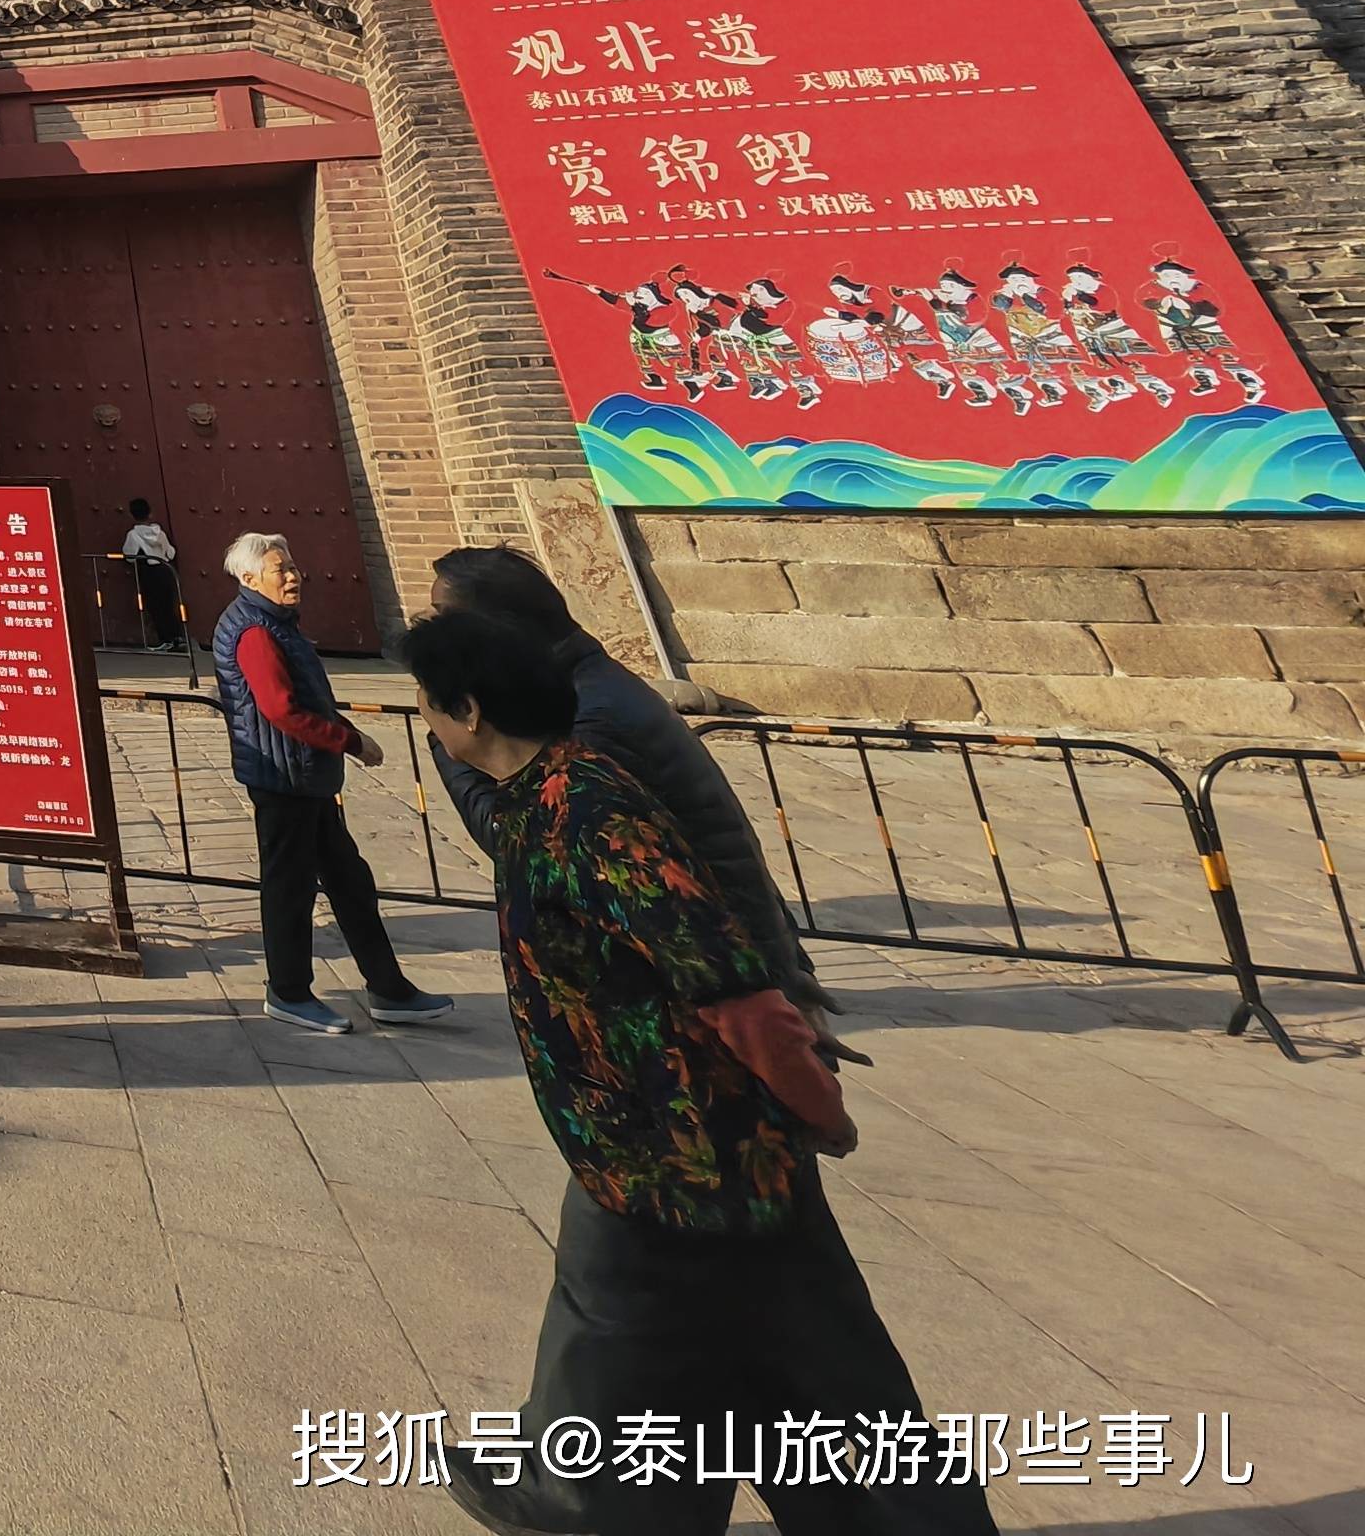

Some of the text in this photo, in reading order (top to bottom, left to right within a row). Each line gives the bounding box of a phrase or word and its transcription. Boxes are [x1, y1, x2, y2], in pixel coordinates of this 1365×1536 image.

[507, 13, 777, 79] 观非遗
[526, 76, 755, 111] 泰山石敢当文化展
[548, 130, 830, 199] 赏锦鲤
